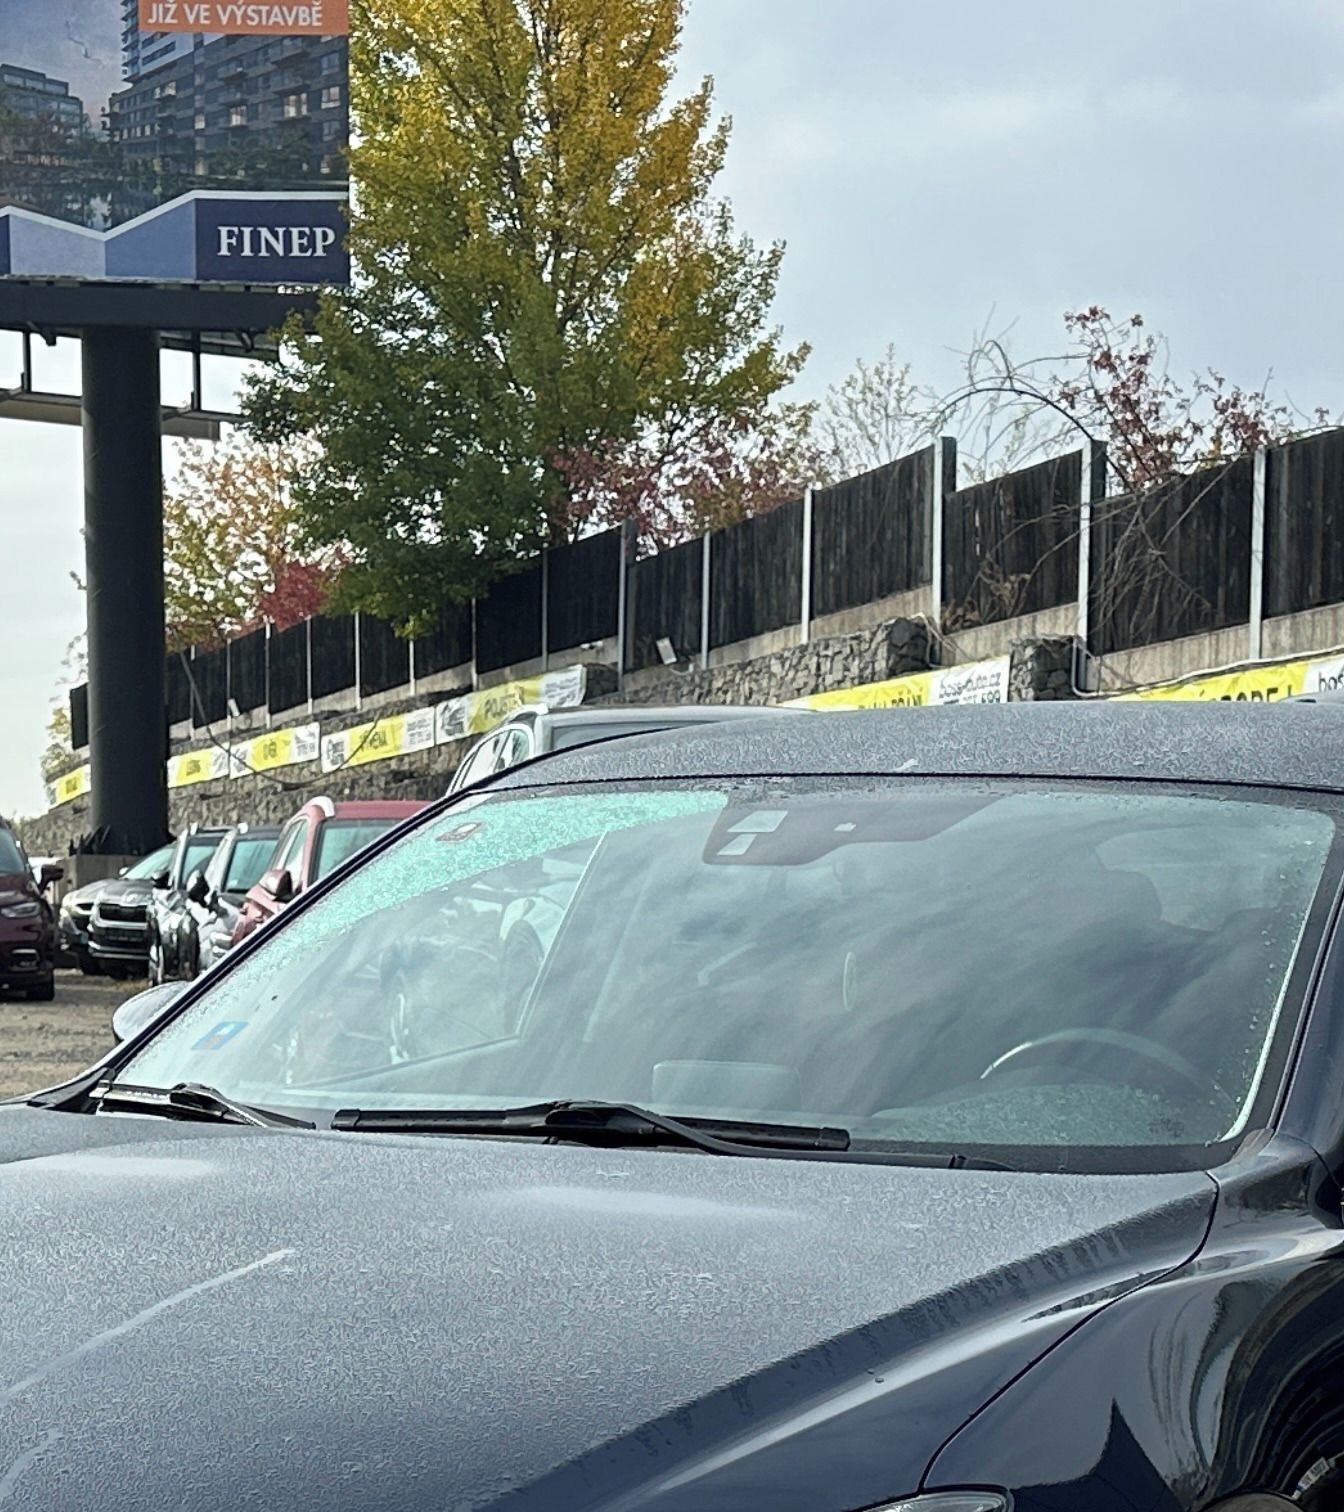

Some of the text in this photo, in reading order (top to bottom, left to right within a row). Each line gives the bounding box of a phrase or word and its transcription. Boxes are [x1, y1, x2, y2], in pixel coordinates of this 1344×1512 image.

[147, 0, 323, 26] JIŽ VE VÝSTAVBĚ
[217, 225, 336, 257] FINEP
